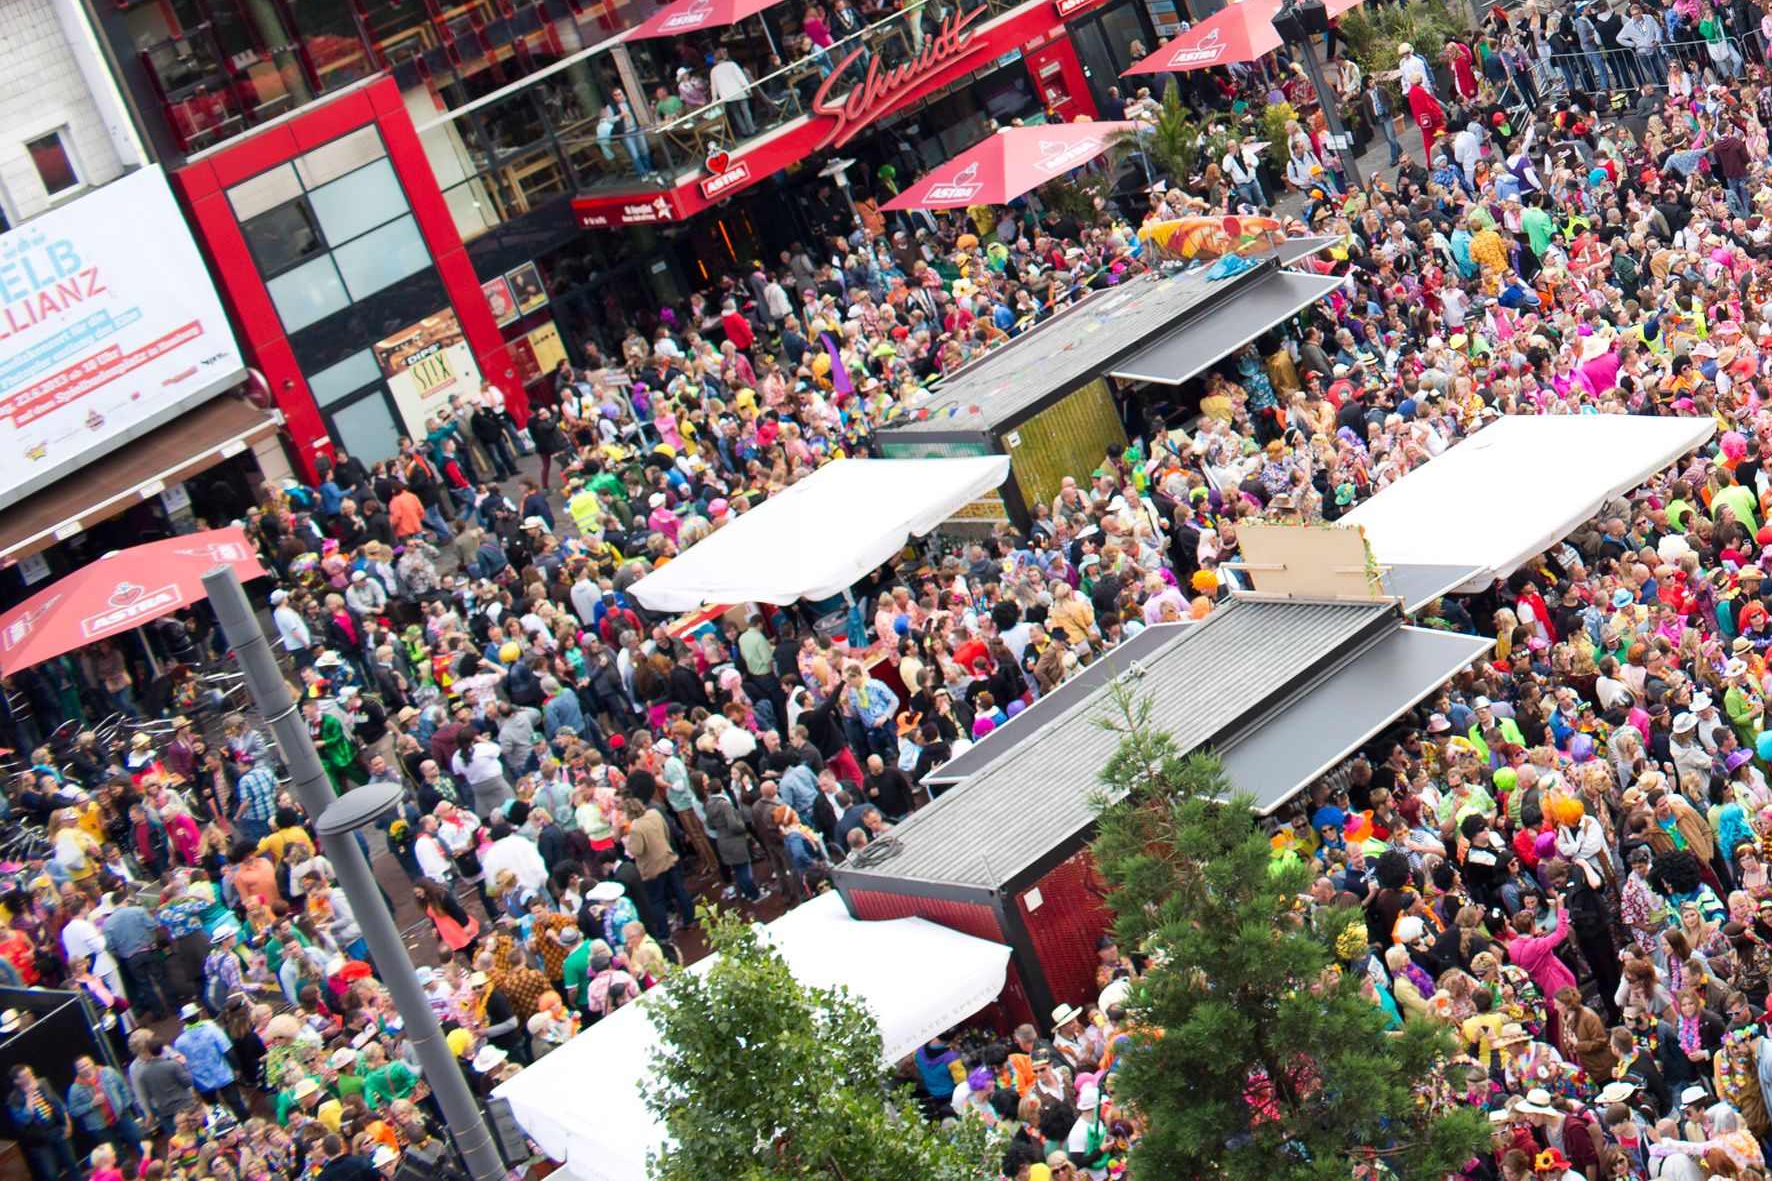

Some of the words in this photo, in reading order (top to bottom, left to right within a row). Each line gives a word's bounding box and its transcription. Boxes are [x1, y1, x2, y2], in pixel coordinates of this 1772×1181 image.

[666, 12, 705, 28] ASTRA
[1174, 48, 1218, 63] ASTRA
[812, 3, 988, 151] Schmidt
[1046, 138, 1099, 170] ASTRA
[706, 167, 746, 194] ASTRA
[929, 186, 974, 201] ASTRA
[0, 239, 83, 305] ELB
[0, 265, 108, 341] LIANZ
[91, 592, 174, 632] ASTRA
